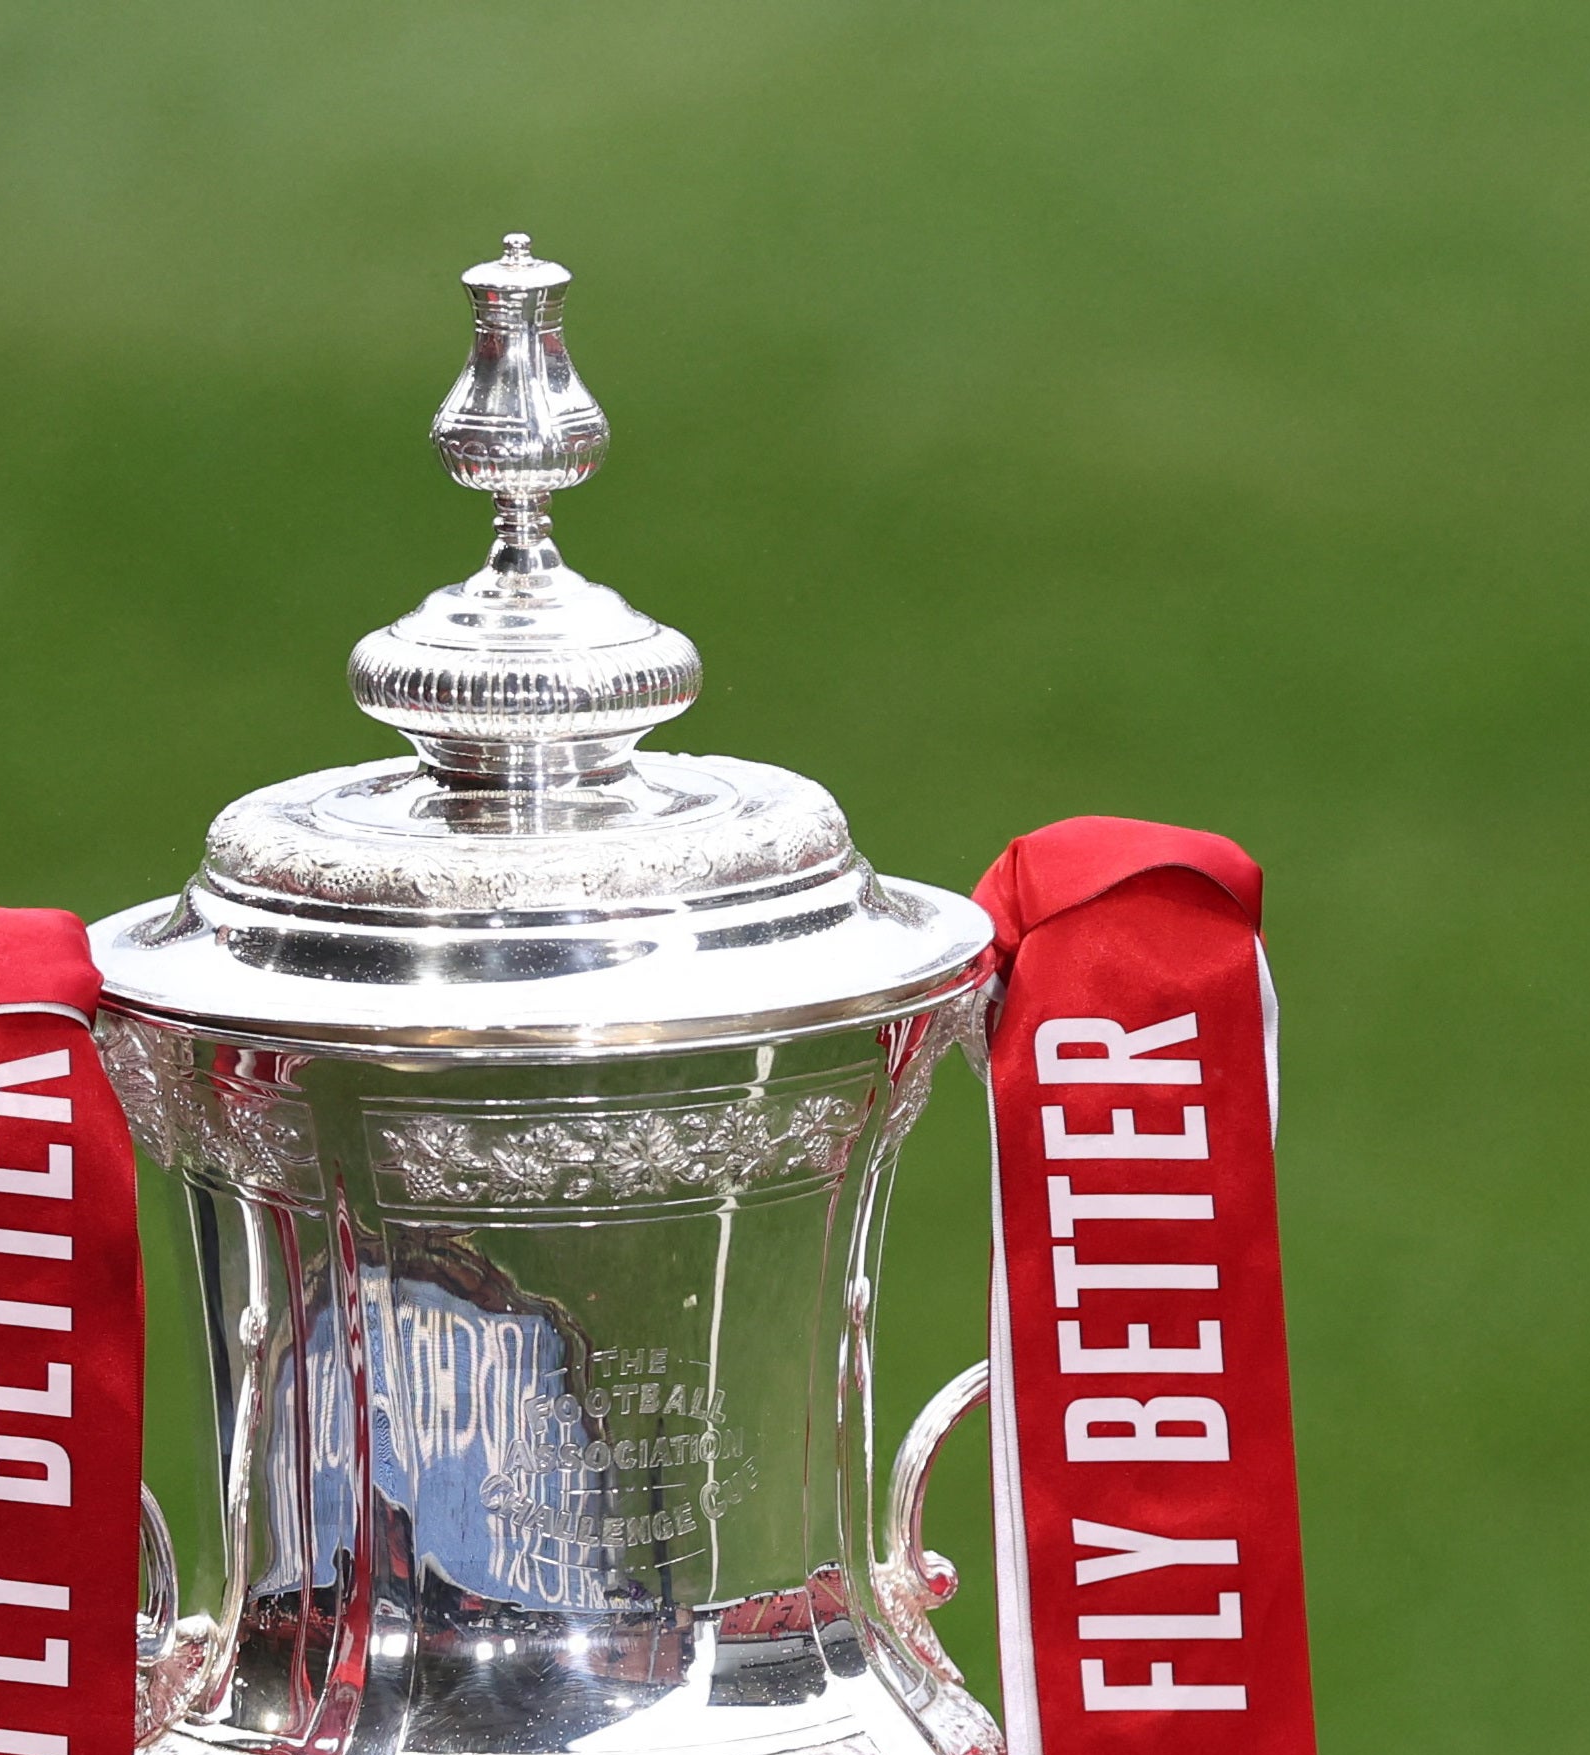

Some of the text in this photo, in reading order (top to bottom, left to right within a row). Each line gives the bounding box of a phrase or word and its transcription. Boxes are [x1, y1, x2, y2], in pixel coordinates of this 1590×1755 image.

[1035, 1012, 1229, 1461] BETTER
[592, 1346, 669, 1378] THE
[523, 1382, 728, 1436] FOOTBALL
[502, 1427, 744, 1475] ASSOCIATION
[479, 1473, 699, 1548] CHALLENGE
[1072, 1519, 1246, 1711] FLY
